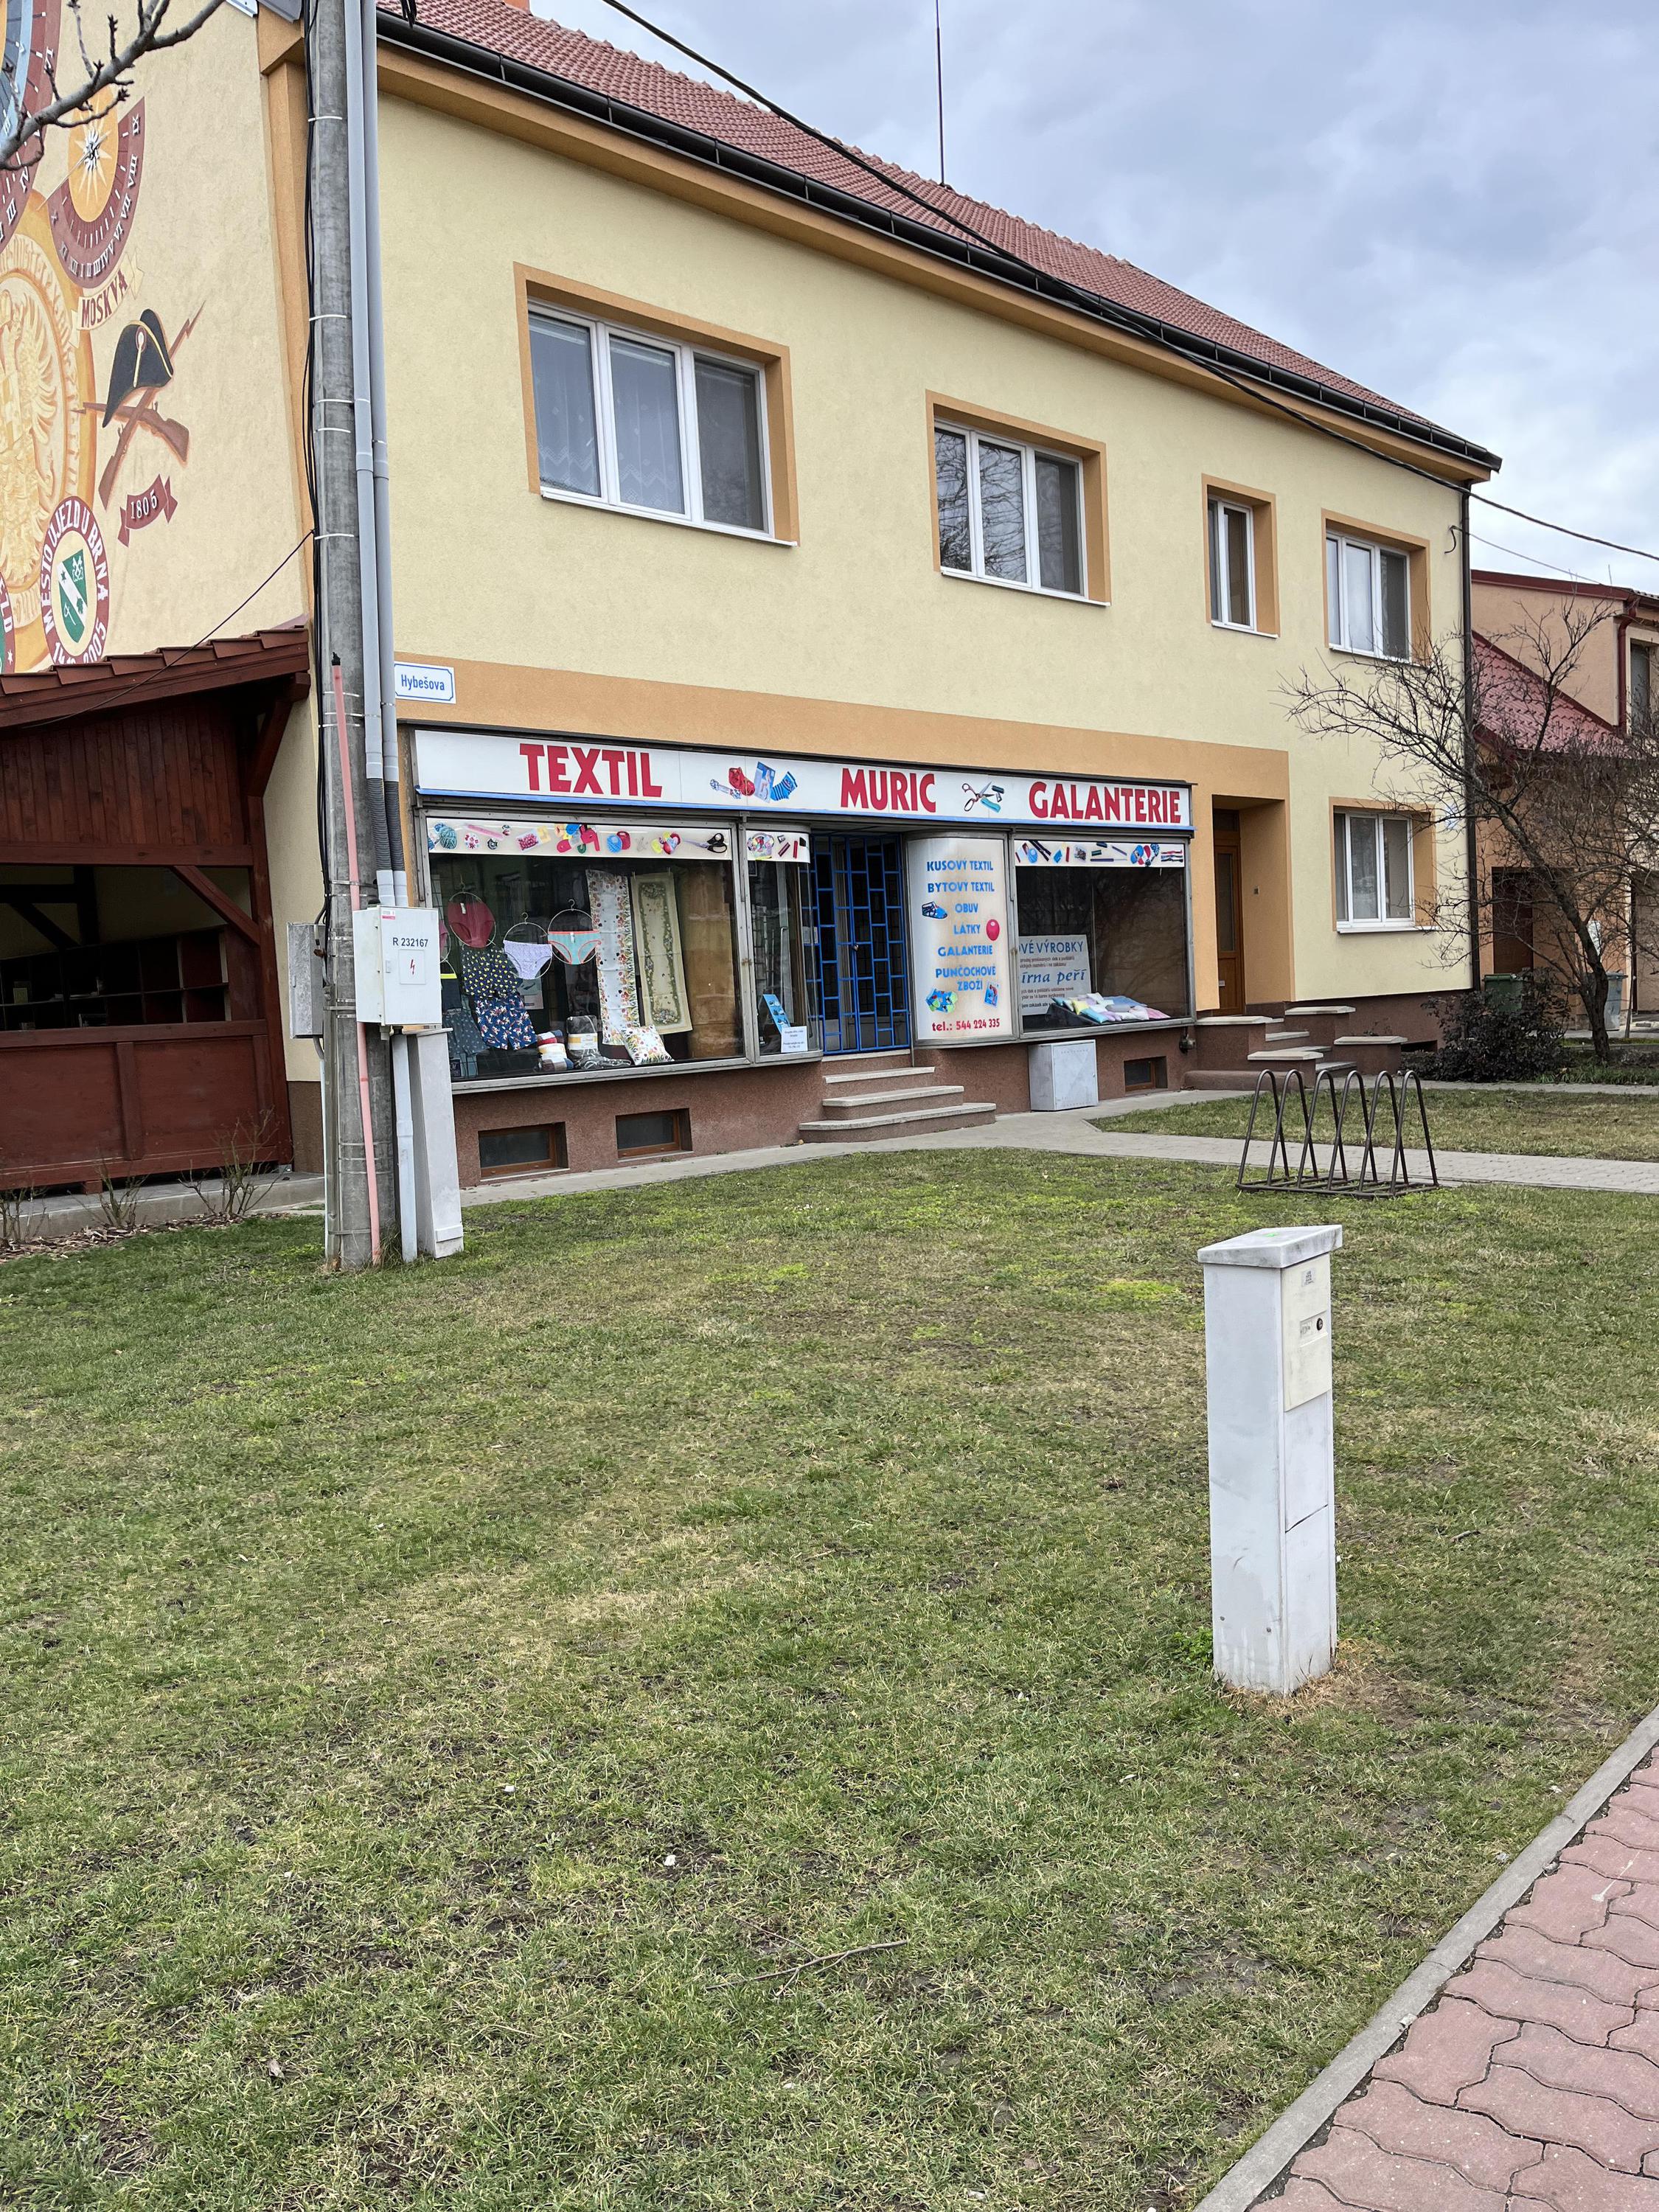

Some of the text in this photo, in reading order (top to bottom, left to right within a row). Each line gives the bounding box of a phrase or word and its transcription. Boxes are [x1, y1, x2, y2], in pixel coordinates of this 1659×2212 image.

[128, 153, 138, 188] VIII
[120, 192, 132, 219] VII
[81, 269, 128, 328] MOSKVA
[131, 489, 157, 519] 1805
[81, 507, 91, 535] U
[88, 521, 109, 601] BRNA
[401, 674, 445, 691] Hybešova
[519, 742, 1181, 824] TEXTIL MURIC GALANTERIE
[926, 858, 994, 872] KUSOVÝ TEXTIL
[927, 880, 995, 893] BYTOVÝ TEXTIL
[954, 902, 979, 914] OBUV
[953, 922, 981, 935] LÁTKY
[392, 937, 428, 947] R 232167
[1019, 939, 1084, 954] VÉ VÝROBKY
[937, 945, 993, 957] GALANTERIE
[935, 963, 997, 978] PUNČOCHOVÉ
[1057, 969, 1088, 985] peří
[931, 1018, 1001, 1032] tel.: 544 224 335
